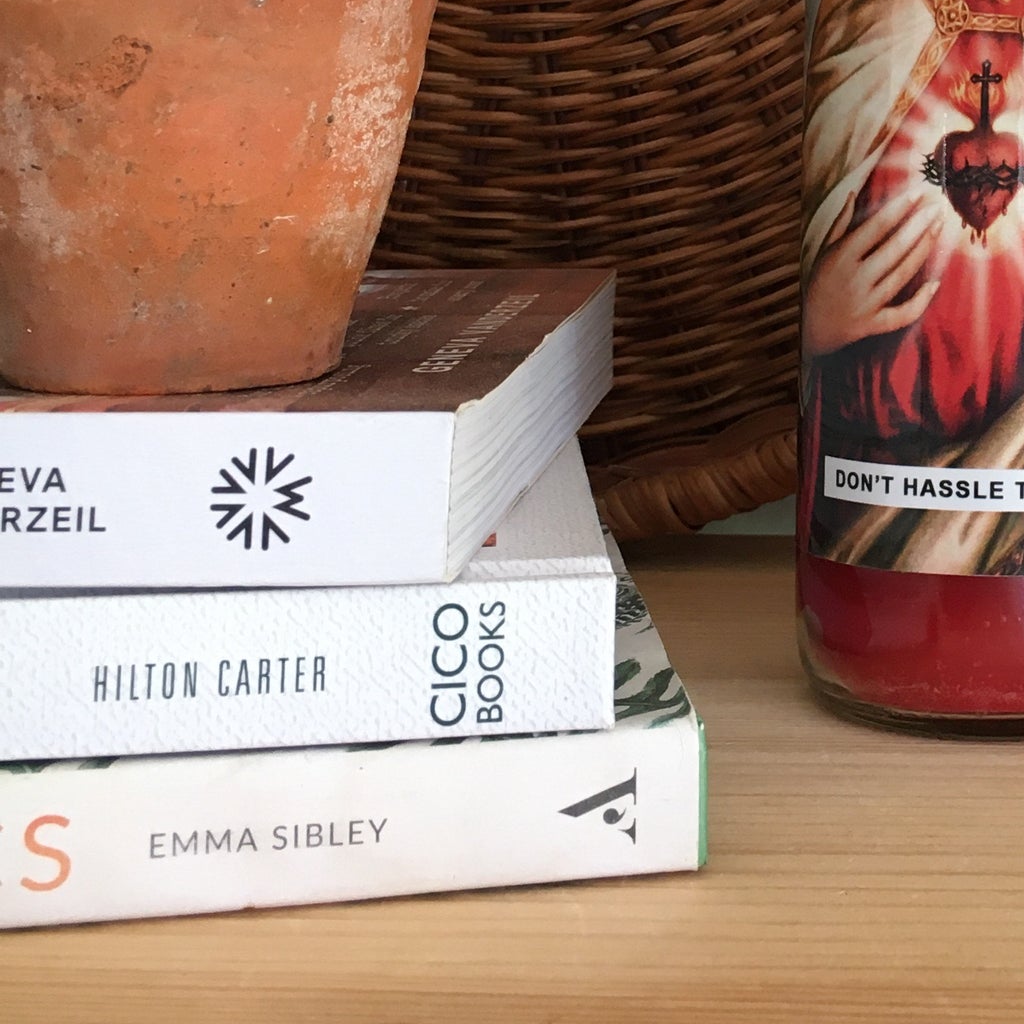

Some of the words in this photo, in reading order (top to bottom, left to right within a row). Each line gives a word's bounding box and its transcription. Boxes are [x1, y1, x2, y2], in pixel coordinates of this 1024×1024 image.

[0, 467, 67, 493] EVA
[835, 469, 894, 494] DON'T
[903, 477, 1004, 500] HASSLE
[1, 506, 107, 532] RZEIL
[93, 661, 198, 702] HILTON
[217, 656, 326, 697] CARTER
[430, 602, 469, 727] CICO
[476, 601, 506, 723] BOOKS
[149, 827, 258, 859] EMMA
[271, 818, 388, 851] SIBLEY
